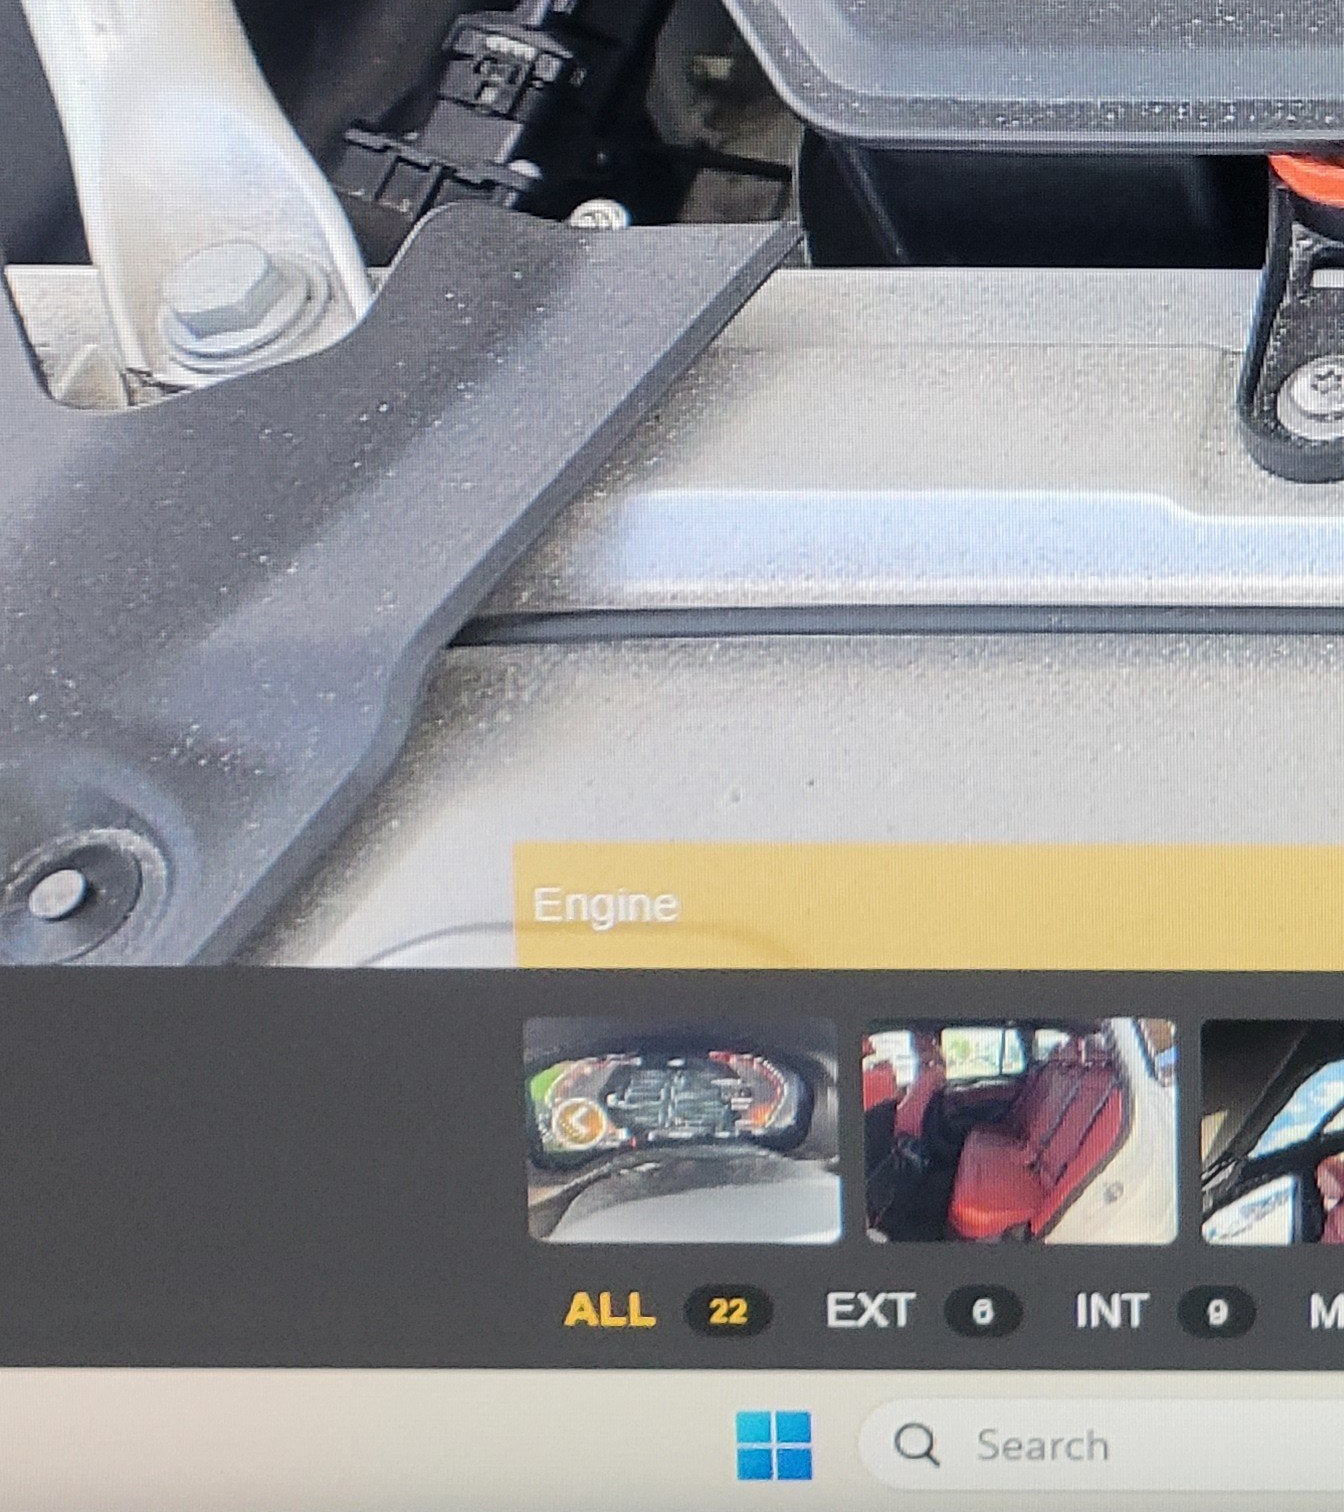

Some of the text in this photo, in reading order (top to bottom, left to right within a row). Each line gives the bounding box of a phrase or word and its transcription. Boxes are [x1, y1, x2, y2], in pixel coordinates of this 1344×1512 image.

[534, 886, 681, 932] Engine
[565, 1292, 748, 1328] ALL 22
[826, 1292, 916, 1328] EXT
[1076, 1293, 1150, 1329] INT
[977, 1428, 1109, 1463] Search
